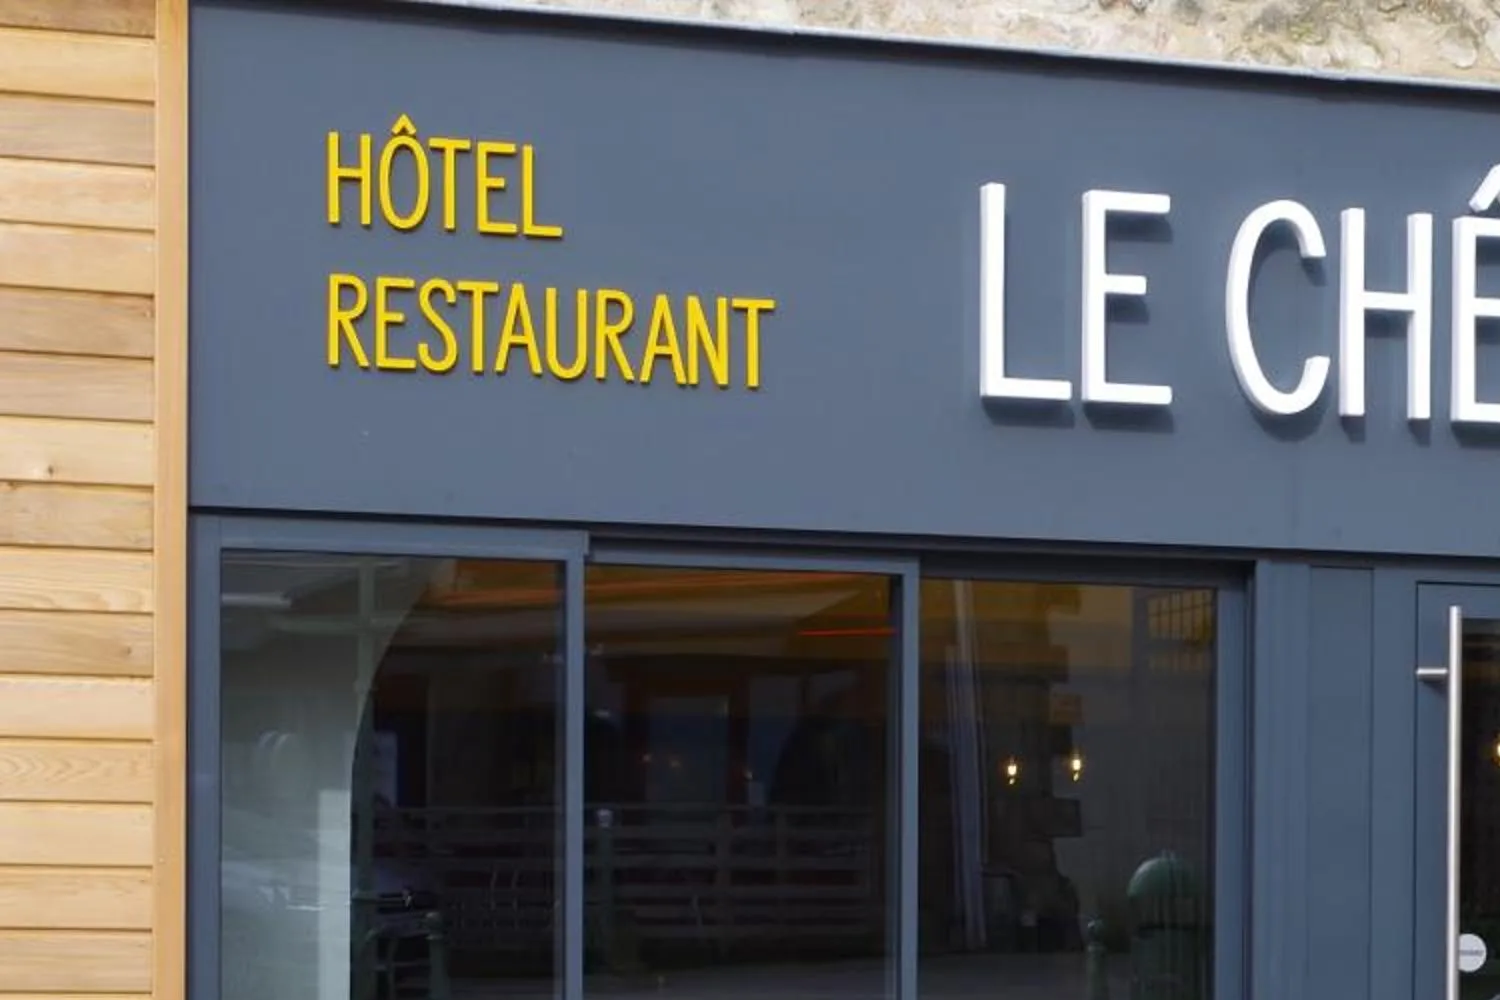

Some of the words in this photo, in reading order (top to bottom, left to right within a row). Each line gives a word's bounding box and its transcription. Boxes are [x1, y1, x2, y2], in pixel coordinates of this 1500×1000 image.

[326, 115, 560, 236] HÔTEL
[327, 272, 776, 387] RESTAURANT
[979, 182, 1173, 405] LE
